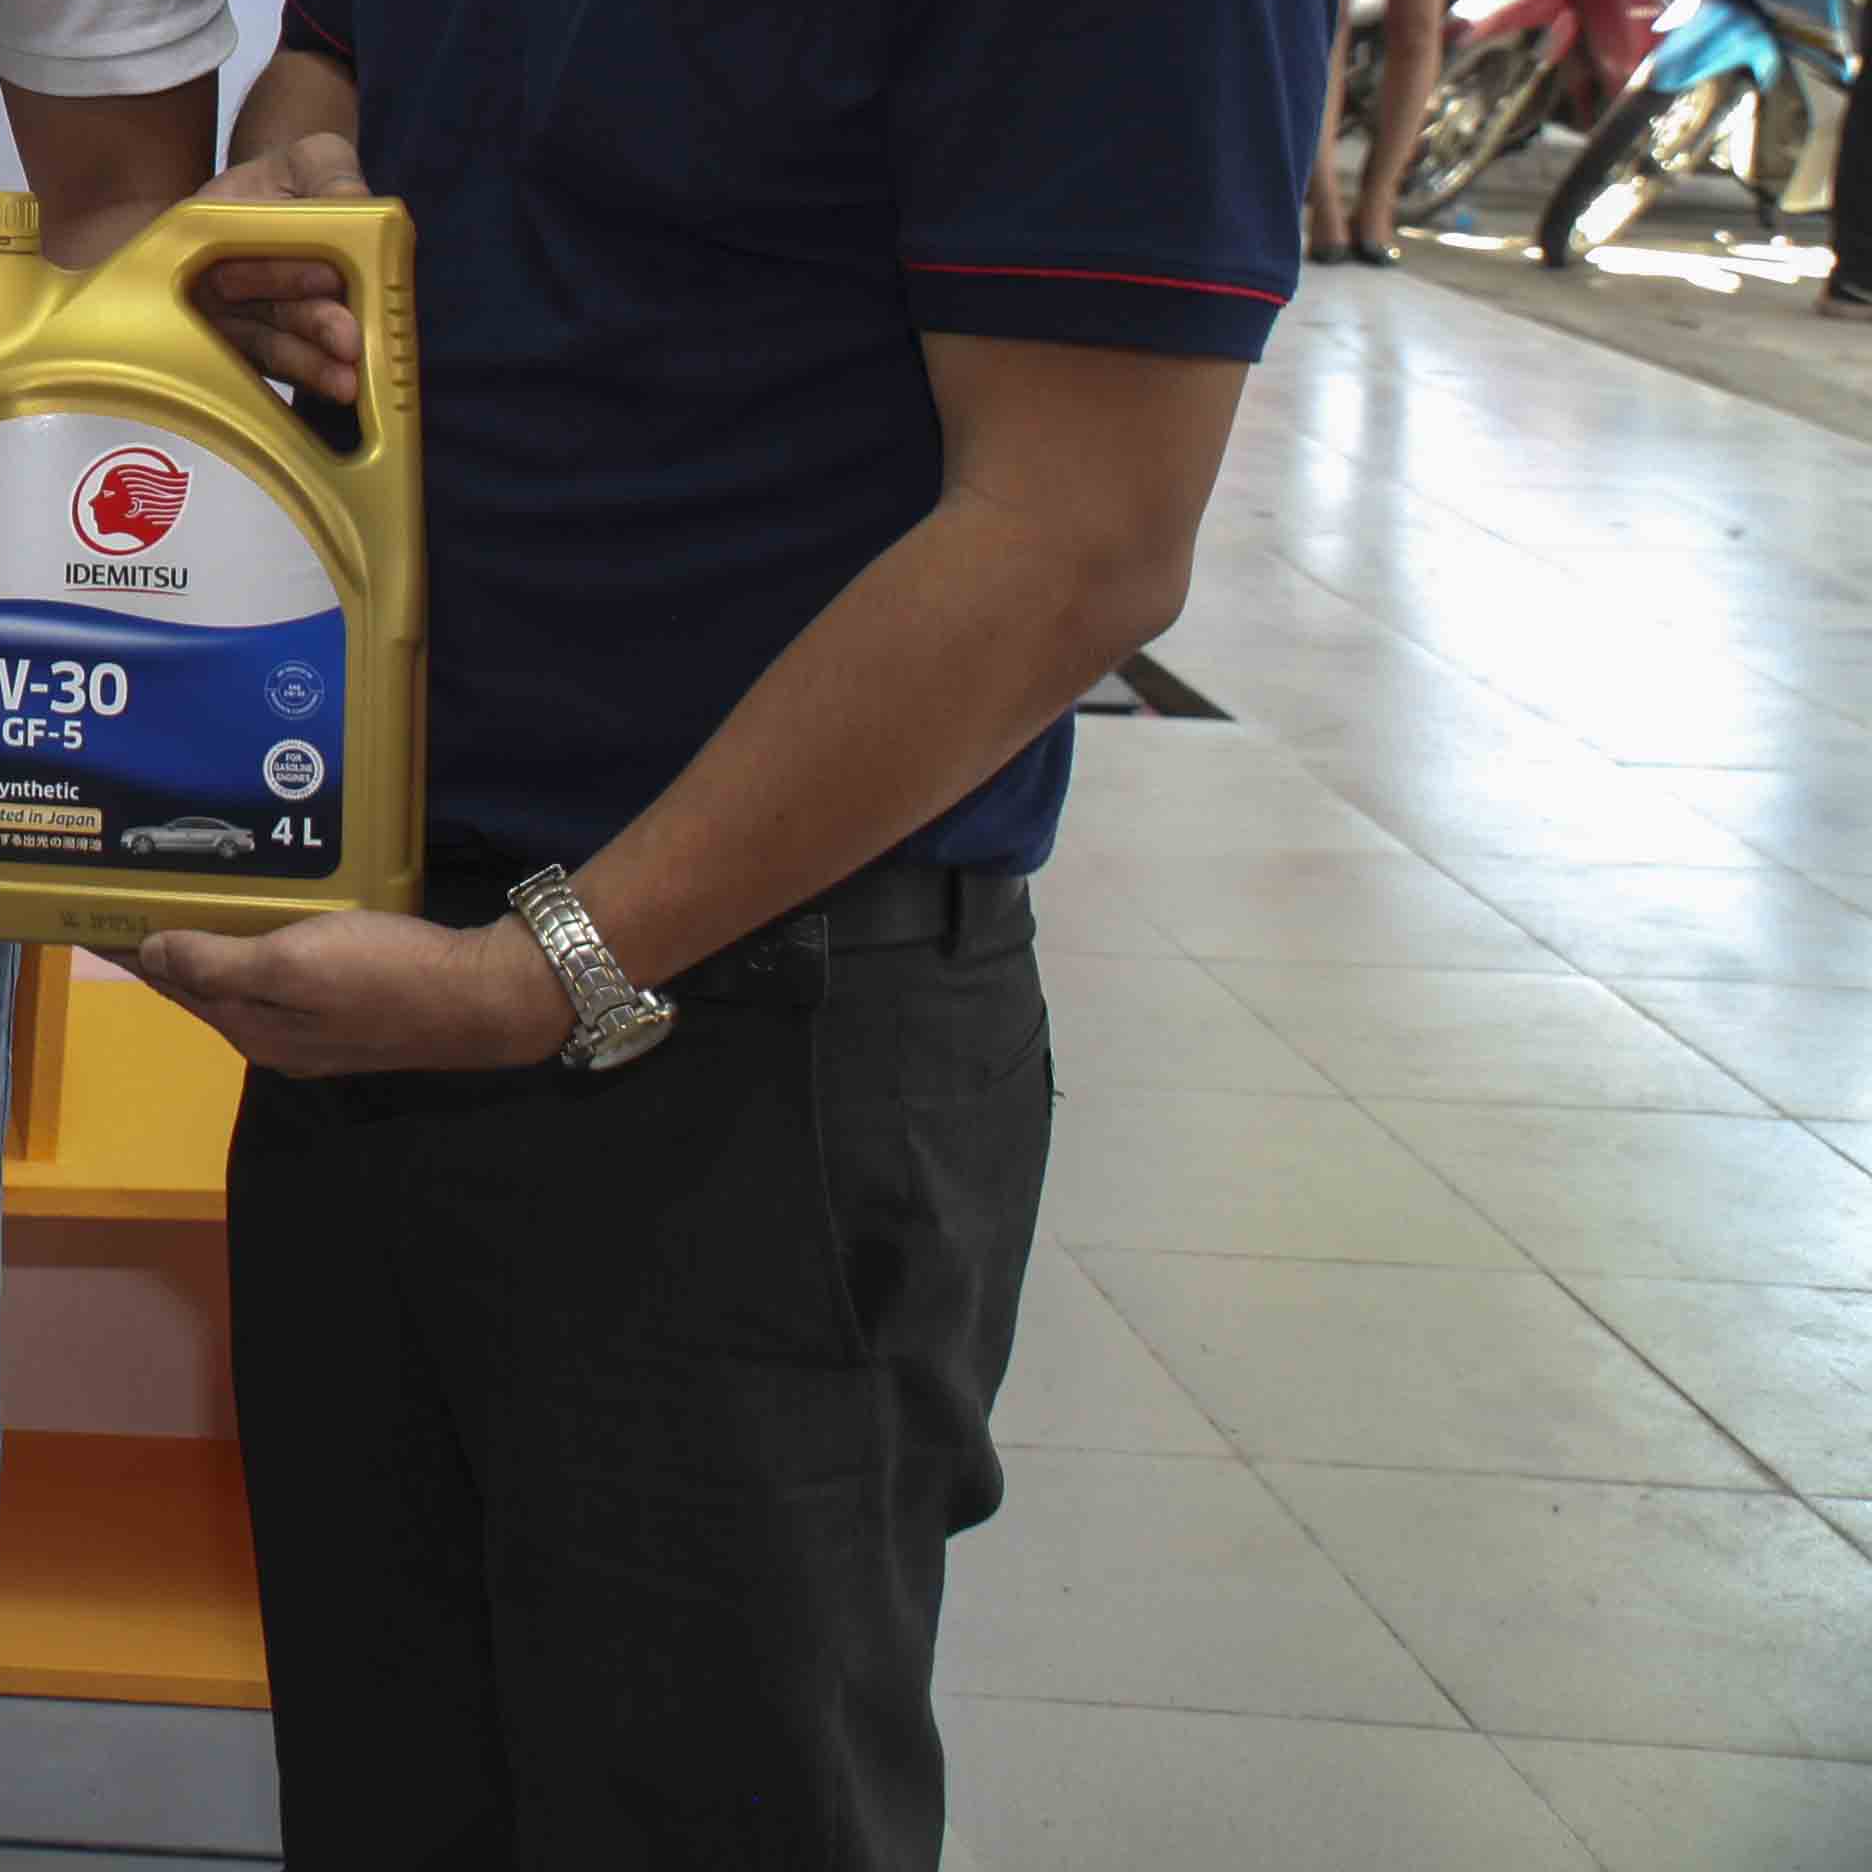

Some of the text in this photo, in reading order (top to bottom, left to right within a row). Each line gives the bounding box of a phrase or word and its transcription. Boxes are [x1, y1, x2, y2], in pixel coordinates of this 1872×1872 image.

[65, 563, 188, 588] IDEMITSU
[29, 811, 42, 824] in
[47, 812, 95, 828] Japan
[271, 816, 322, 848] 4 L
